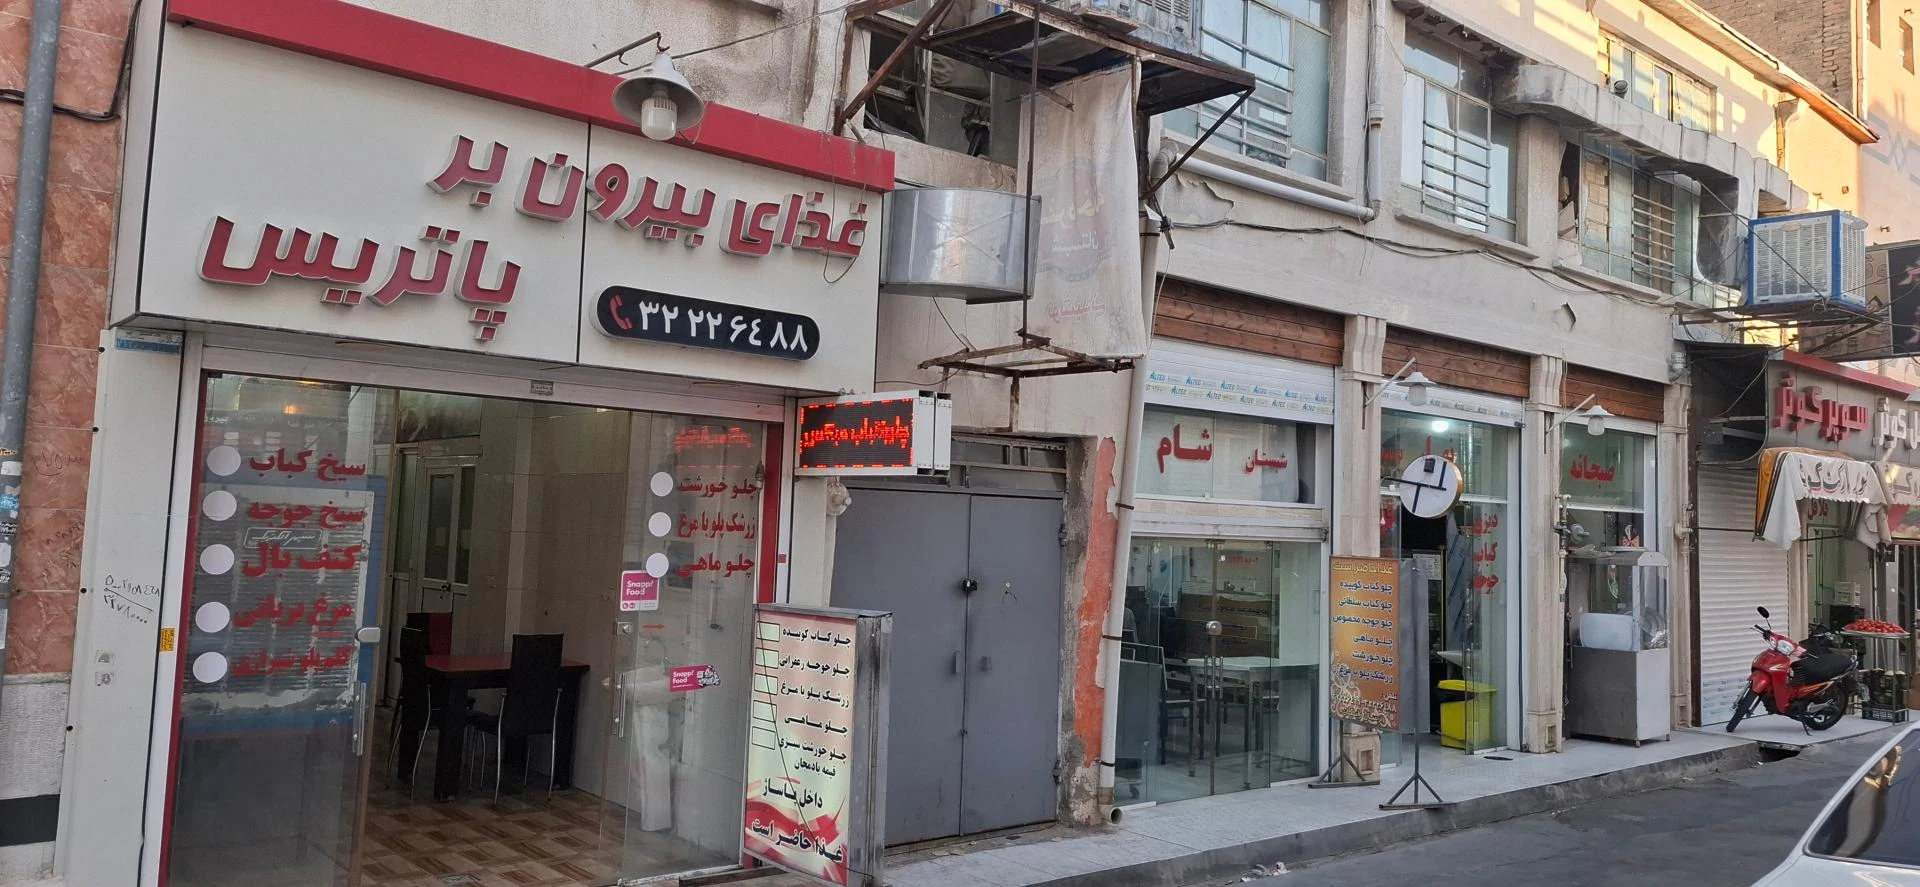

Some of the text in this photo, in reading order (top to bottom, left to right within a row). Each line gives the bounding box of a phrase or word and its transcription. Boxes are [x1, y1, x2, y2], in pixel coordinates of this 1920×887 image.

[427, 134, 868, 258] غذای بیرون بر
[199, 215, 522, 342] پاتریس
[1821, 398, 1869, 442] سوپر
[1157, 423, 1288, 474] شام شبستان
[249, 447, 366, 482] سیخ کباب
[1569, 453, 1616, 489] صبحانه
[677, 474, 728, 498] خورشت
[247, 500, 367, 529] سیخ جوجه
[677, 508, 756, 539] زرشک پلو با مرغ
[242, 541, 292, 578] بال
[676, 552, 755, 577] چلو ماهی
[626, 588, 646, 596] Food
[1339, 580, 1393, 595] چلو کباب کوبیده
[1338, 596, 1393, 613] چلو کباب سلطانی
[1332, 614, 1393, 632] چلو جوجه مخصوص
[782, 628, 851, 649] چلو کباب کوبیده
[1352, 633, 1393, 649] چلو ماهی
[779, 654, 850, 679] چلو جوجه زعفرانی
[1351, 650, 1394, 667] چلو خورشت
[672, 670, 694, 679] Snapp!
[672, 677, 688, 685] Food
[1338, 665, 1352, 678] مرغ
[1360, 668, 1370, 681] پلو
[1370, 669, 1393, 684] زرشک
[780, 680, 849, 708] زرشک پلو با مرغ
[784, 714, 848, 738] چلو ماهی
[779, 737, 847, 764] چلو خورشت سبزی
[793, 757, 836, 779] قیمه بادمجان
[799, 788, 823, 808] داخل
[751, 818, 844, 863] غذا حاضر است
